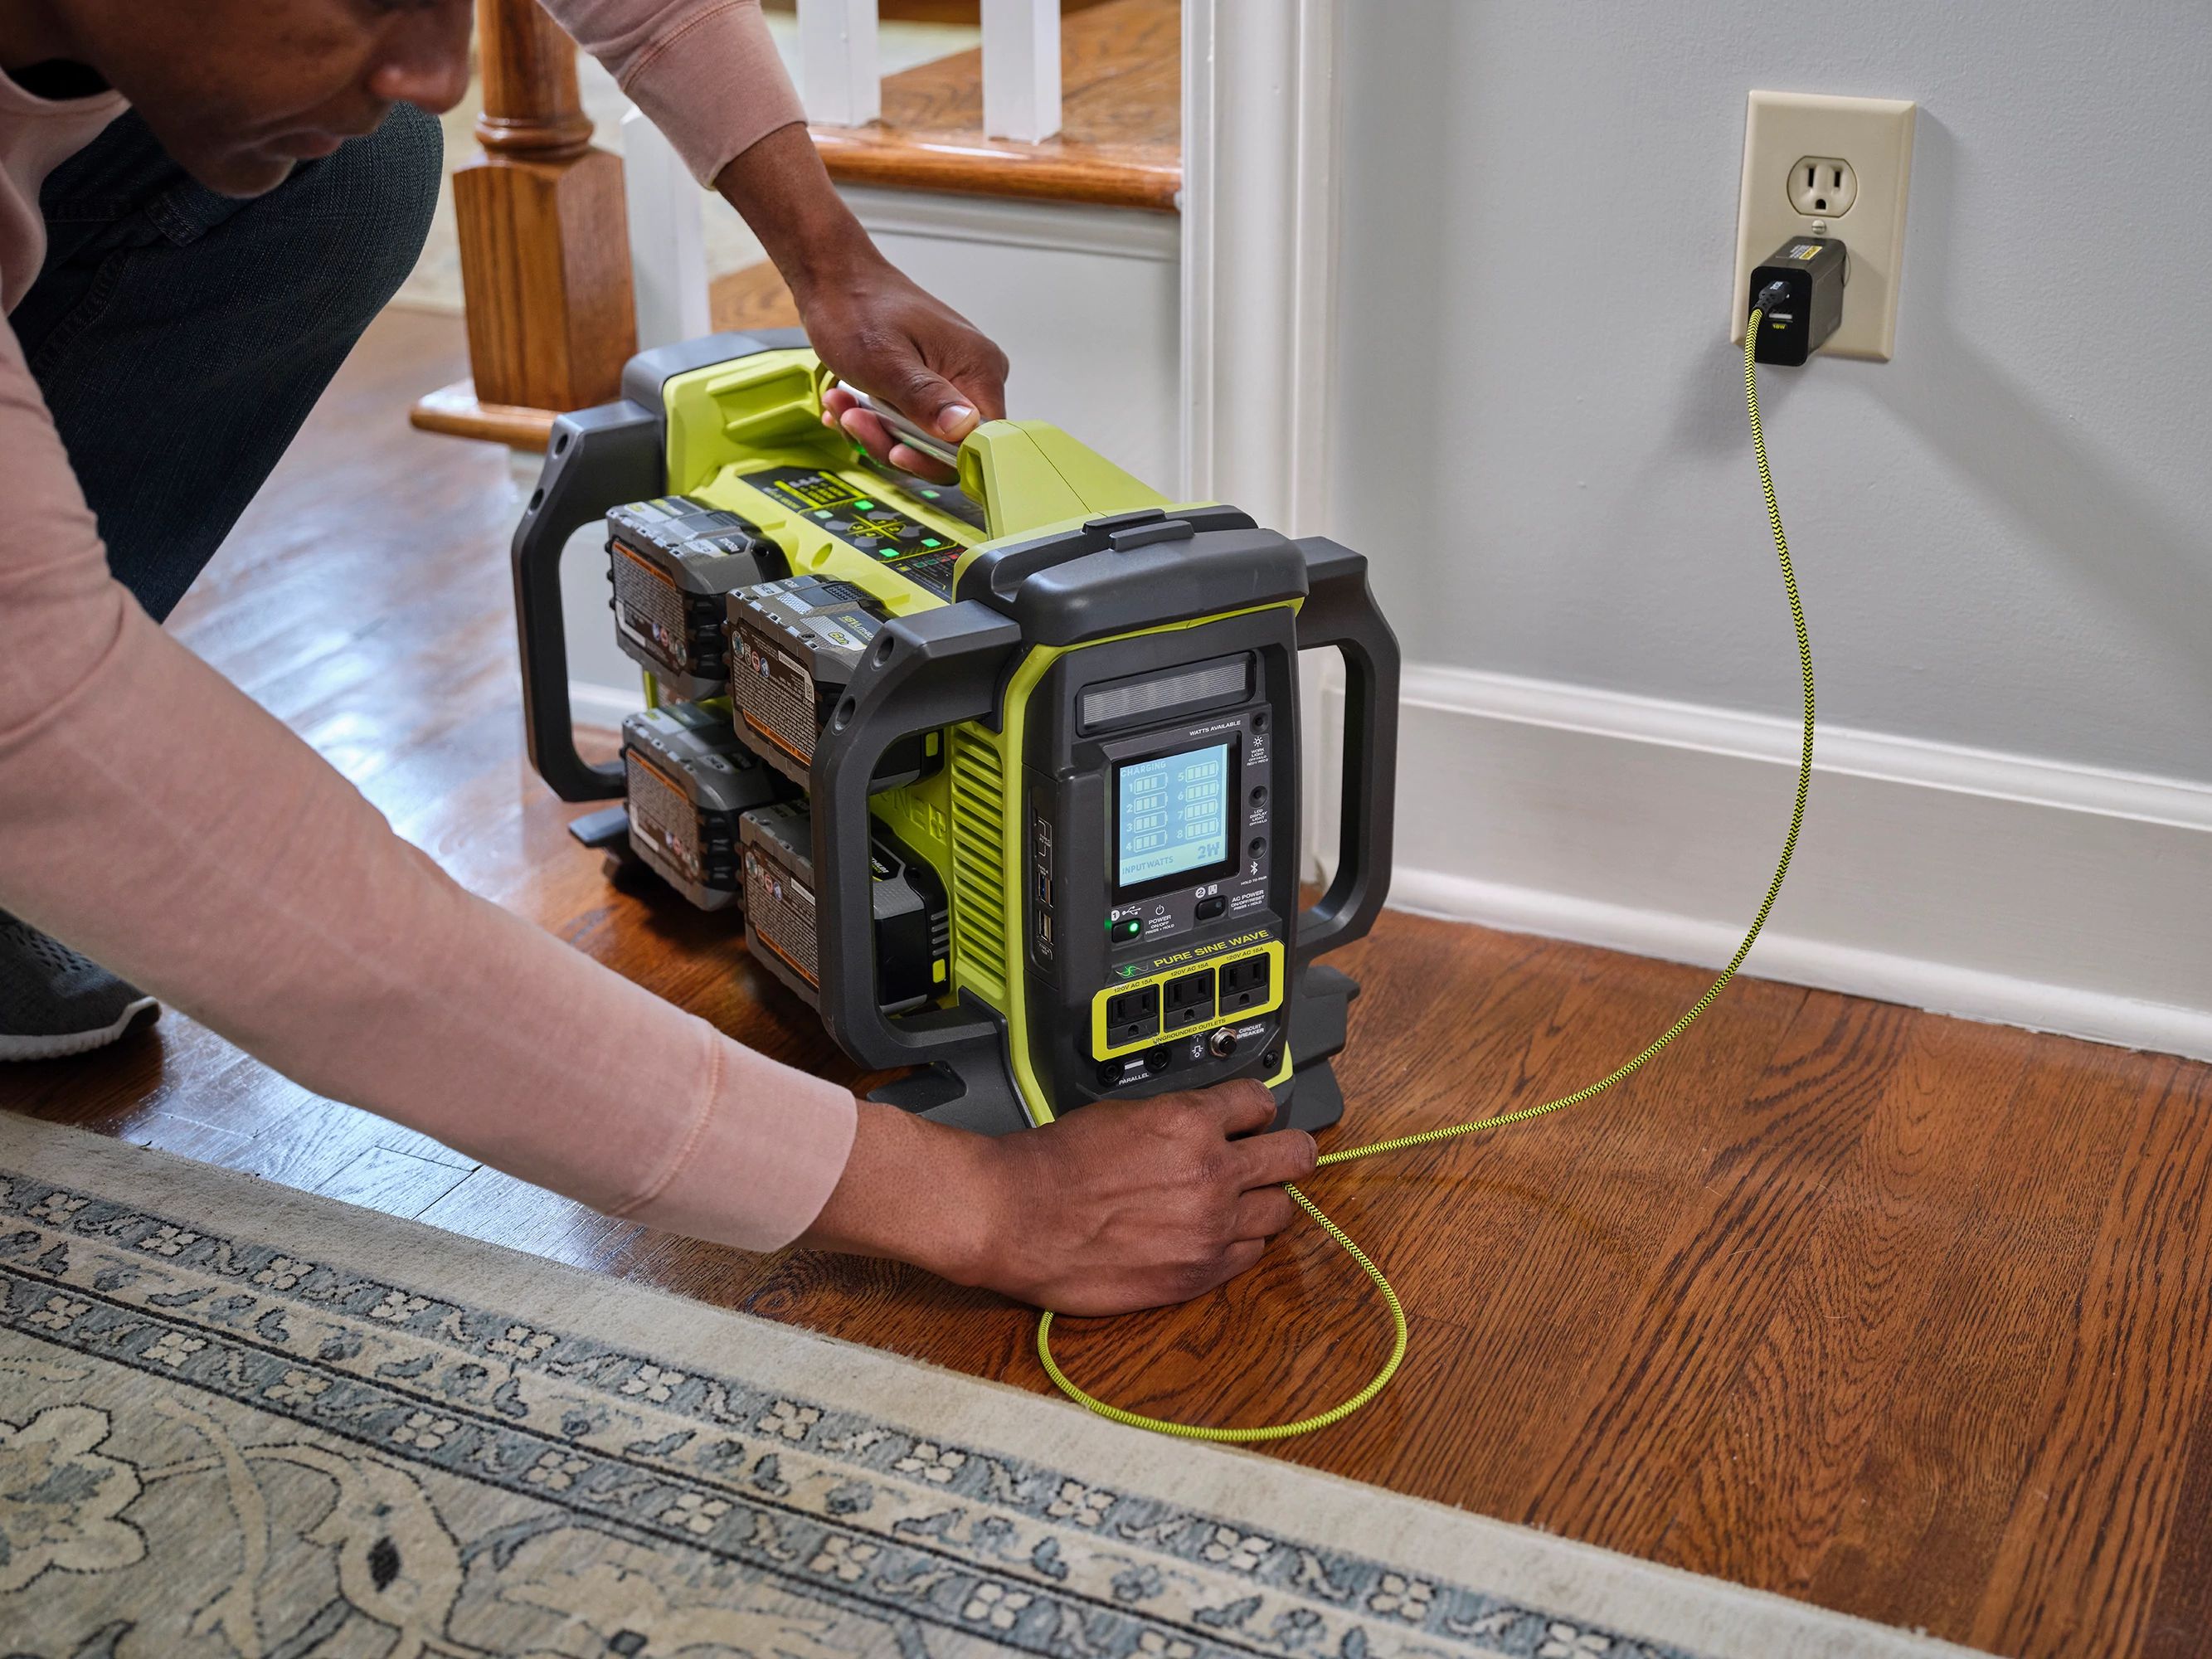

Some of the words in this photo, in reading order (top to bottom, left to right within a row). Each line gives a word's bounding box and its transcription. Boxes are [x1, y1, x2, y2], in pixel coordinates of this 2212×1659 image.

[1189, 727, 1209, 737] WATTS
[1210, 720, 1241, 731] AVAILABLE
[1121, 761, 1166, 777] CHARGING
[1178, 771, 1185, 781] 5
[1128, 783, 1133, 792] 1
[1178, 791, 1184, 800] 6
[1127, 803, 1134, 813] 2
[1178, 810, 1184, 820] 7
[1126, 823, 1133, 832] 3
[1177, 830, 1184, 839] 8
[1125, 842, 1134, 851] 4
[1242, 889, 1264, 900] POWER
[1148, 914, 1171, 925] POWER
[1150, 921, 1169, 929] ON/OFF
[1154, 951, 1191, 968] PURE
[1194, 941, 1228, 956] SINE
[1228, 929, 1270, 946] WAVE
[1226, 953, 1242, 961] 120V
[1170, 968, 1186, 977] 120V
[1186, 966, 1197, 974] AC
[1197, 961, 1209, 970] 15A
[1114, 985, 1130, 994] 120V
[1130, 981, 1141, 990] AC
[1153, 1026, 1198, 1044] UNGROUNDED
[1198, 1018, 1226, 1030] OUTLETS
[1237, 1027, 1265, 1039] BREAKER
[1238, 1023, 1262, 1034] CIRCUIT
[1119, 1072, 1150, 1086] PARALLEL
